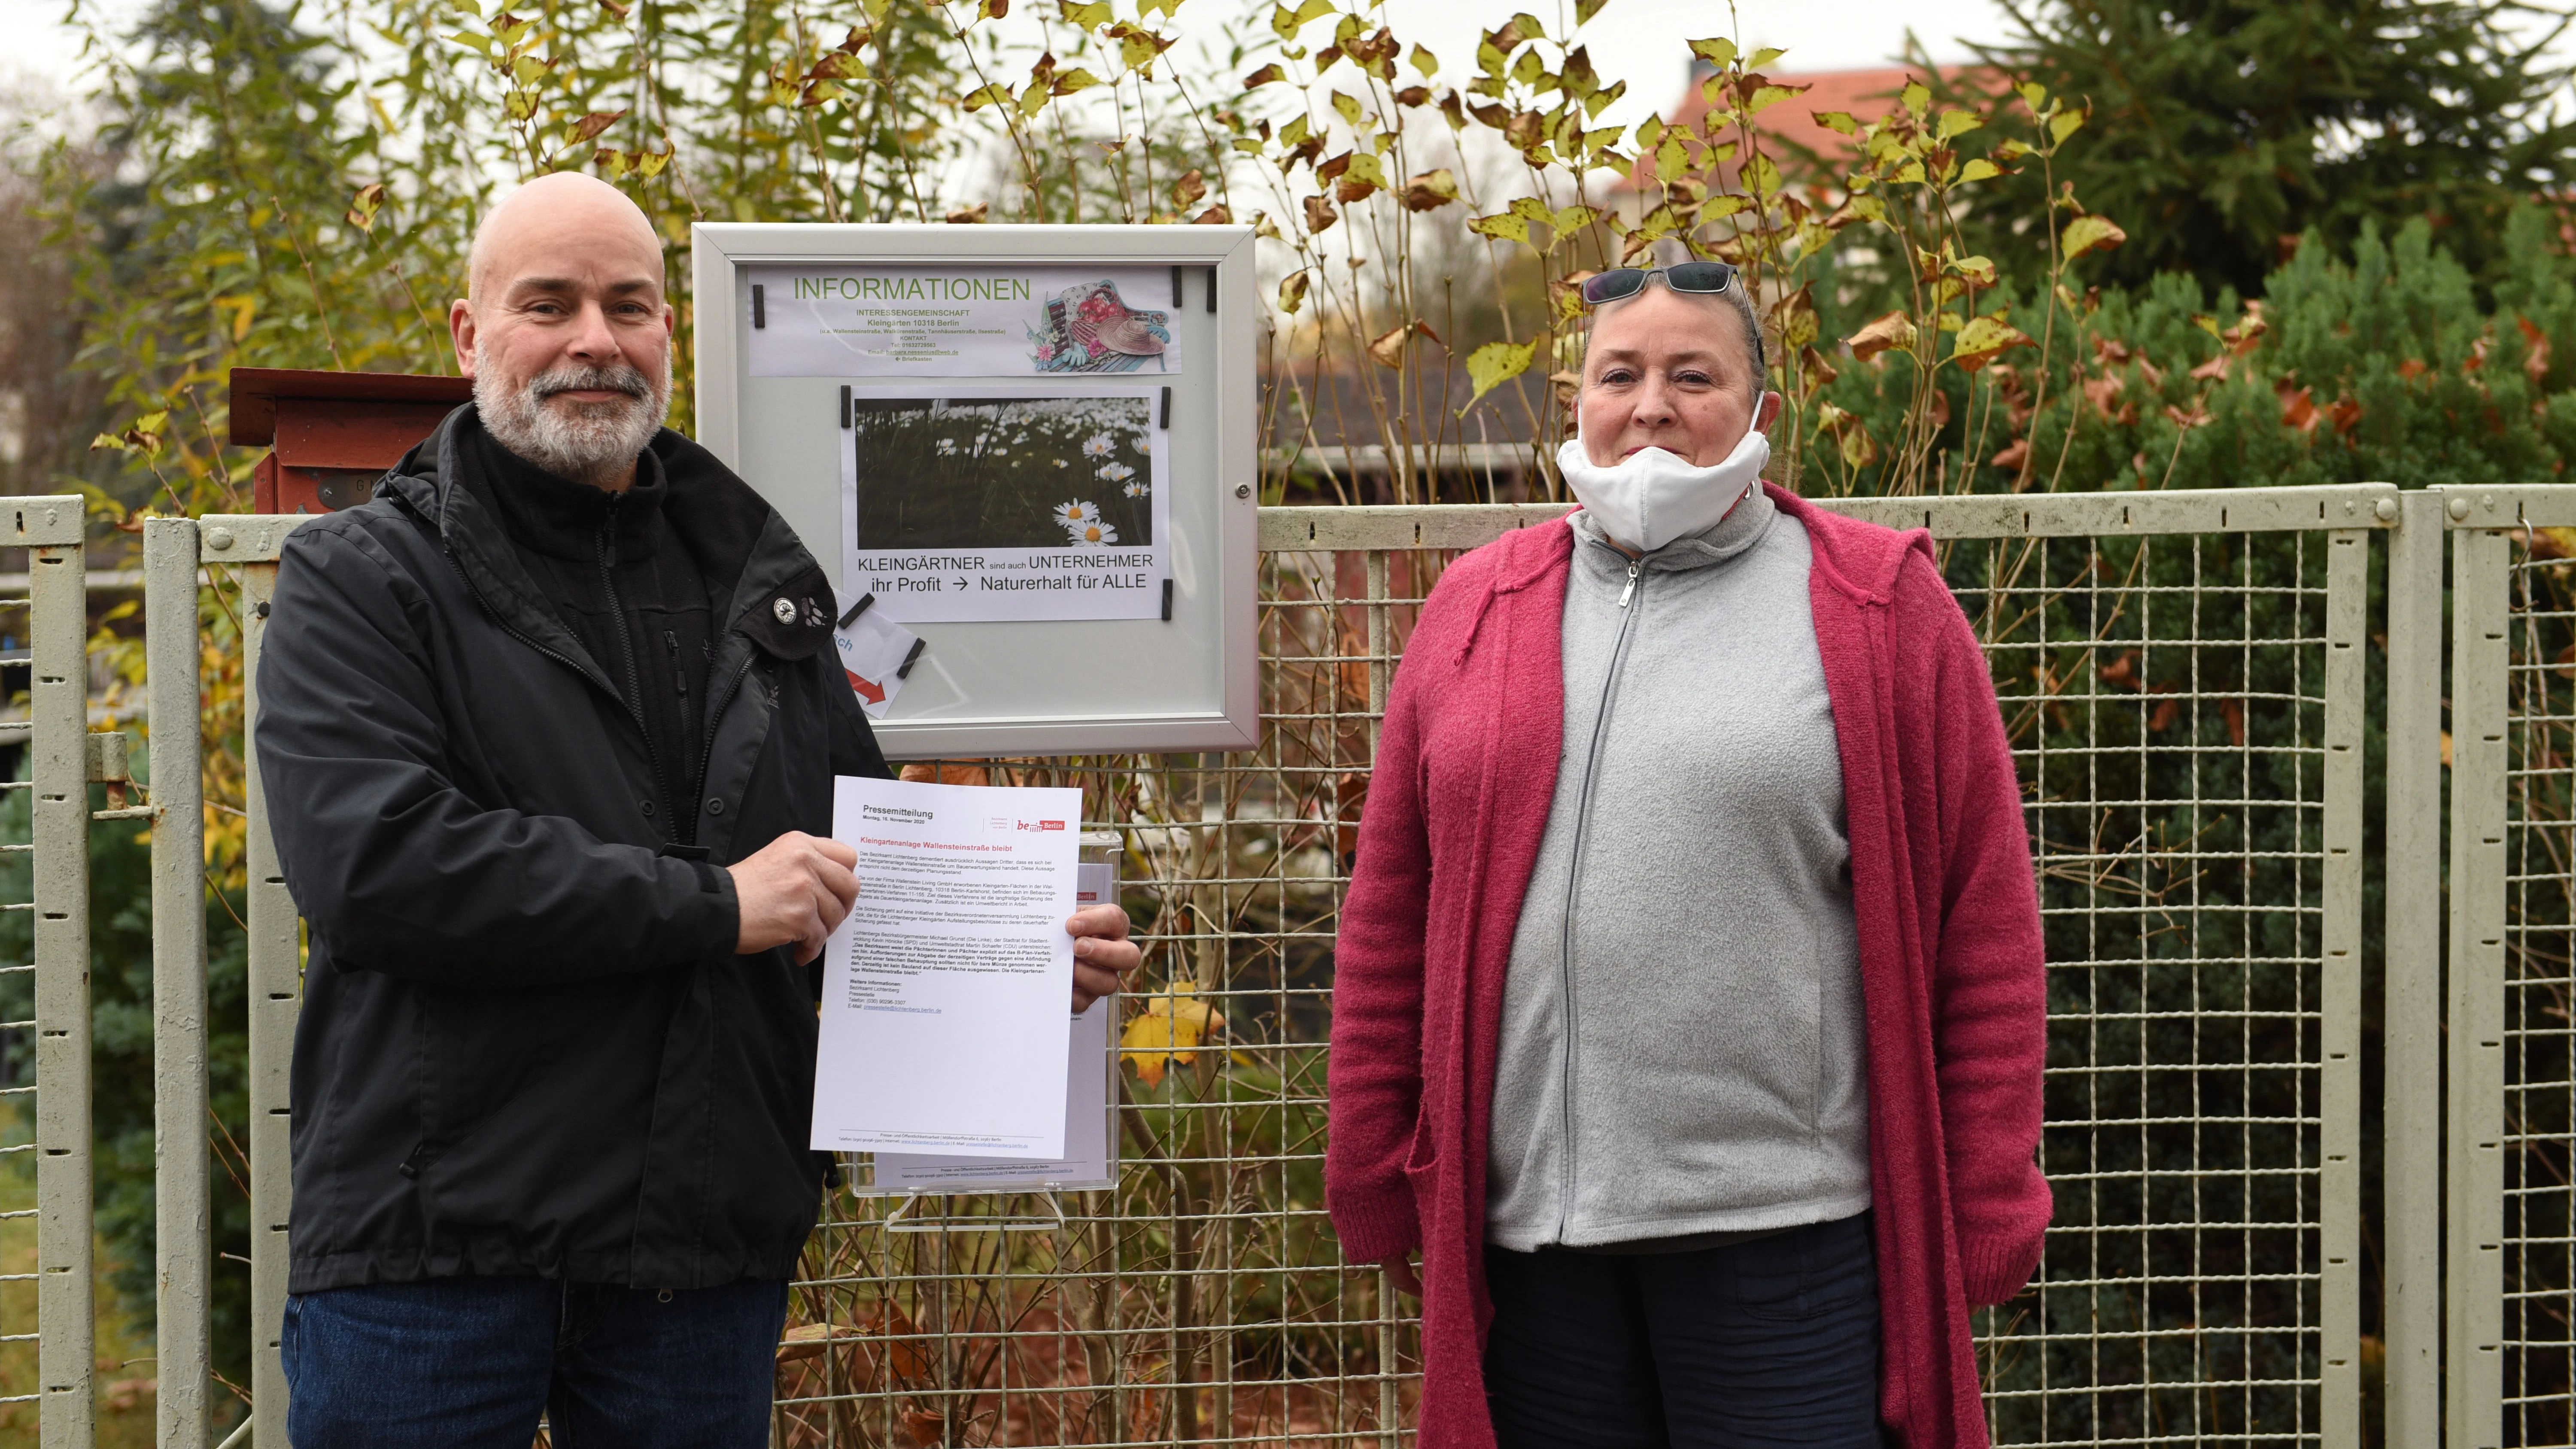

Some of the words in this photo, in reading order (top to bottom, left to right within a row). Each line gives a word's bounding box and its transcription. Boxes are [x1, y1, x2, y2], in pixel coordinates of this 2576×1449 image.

[794, 277, 1030, 301] INFORMATIONEN
[867, 319, 911, 327] Kleingärten
[858, 553, 984, 572] KLEINGÄRTNER
[990, 561, 1006, 570] sind
[1008, 561, 1026, 570] auch
[1029, 553, 1153, 569] UNTERNEHMER
[872, 576, 892, 592] ihr
[898, 574, 941, 592] Profit
[981, 571, 1072, 591] Naturerhalt
[1074, 571, 1098, 589] für
[1103, 570, 1146, 589] ALLE
[863, 805, 933, 819] Pressemitteilung
[1017, 820, 1029, 830] be
[860, 836, 920, 849] Kleingartenanlage
[923, 842, 989, 851] Wallensteinstraße
[867, 857, 904, 866] Kleingartenanlage
[944, 911, 1019, 920] Bezirksverordnetenversammlung
